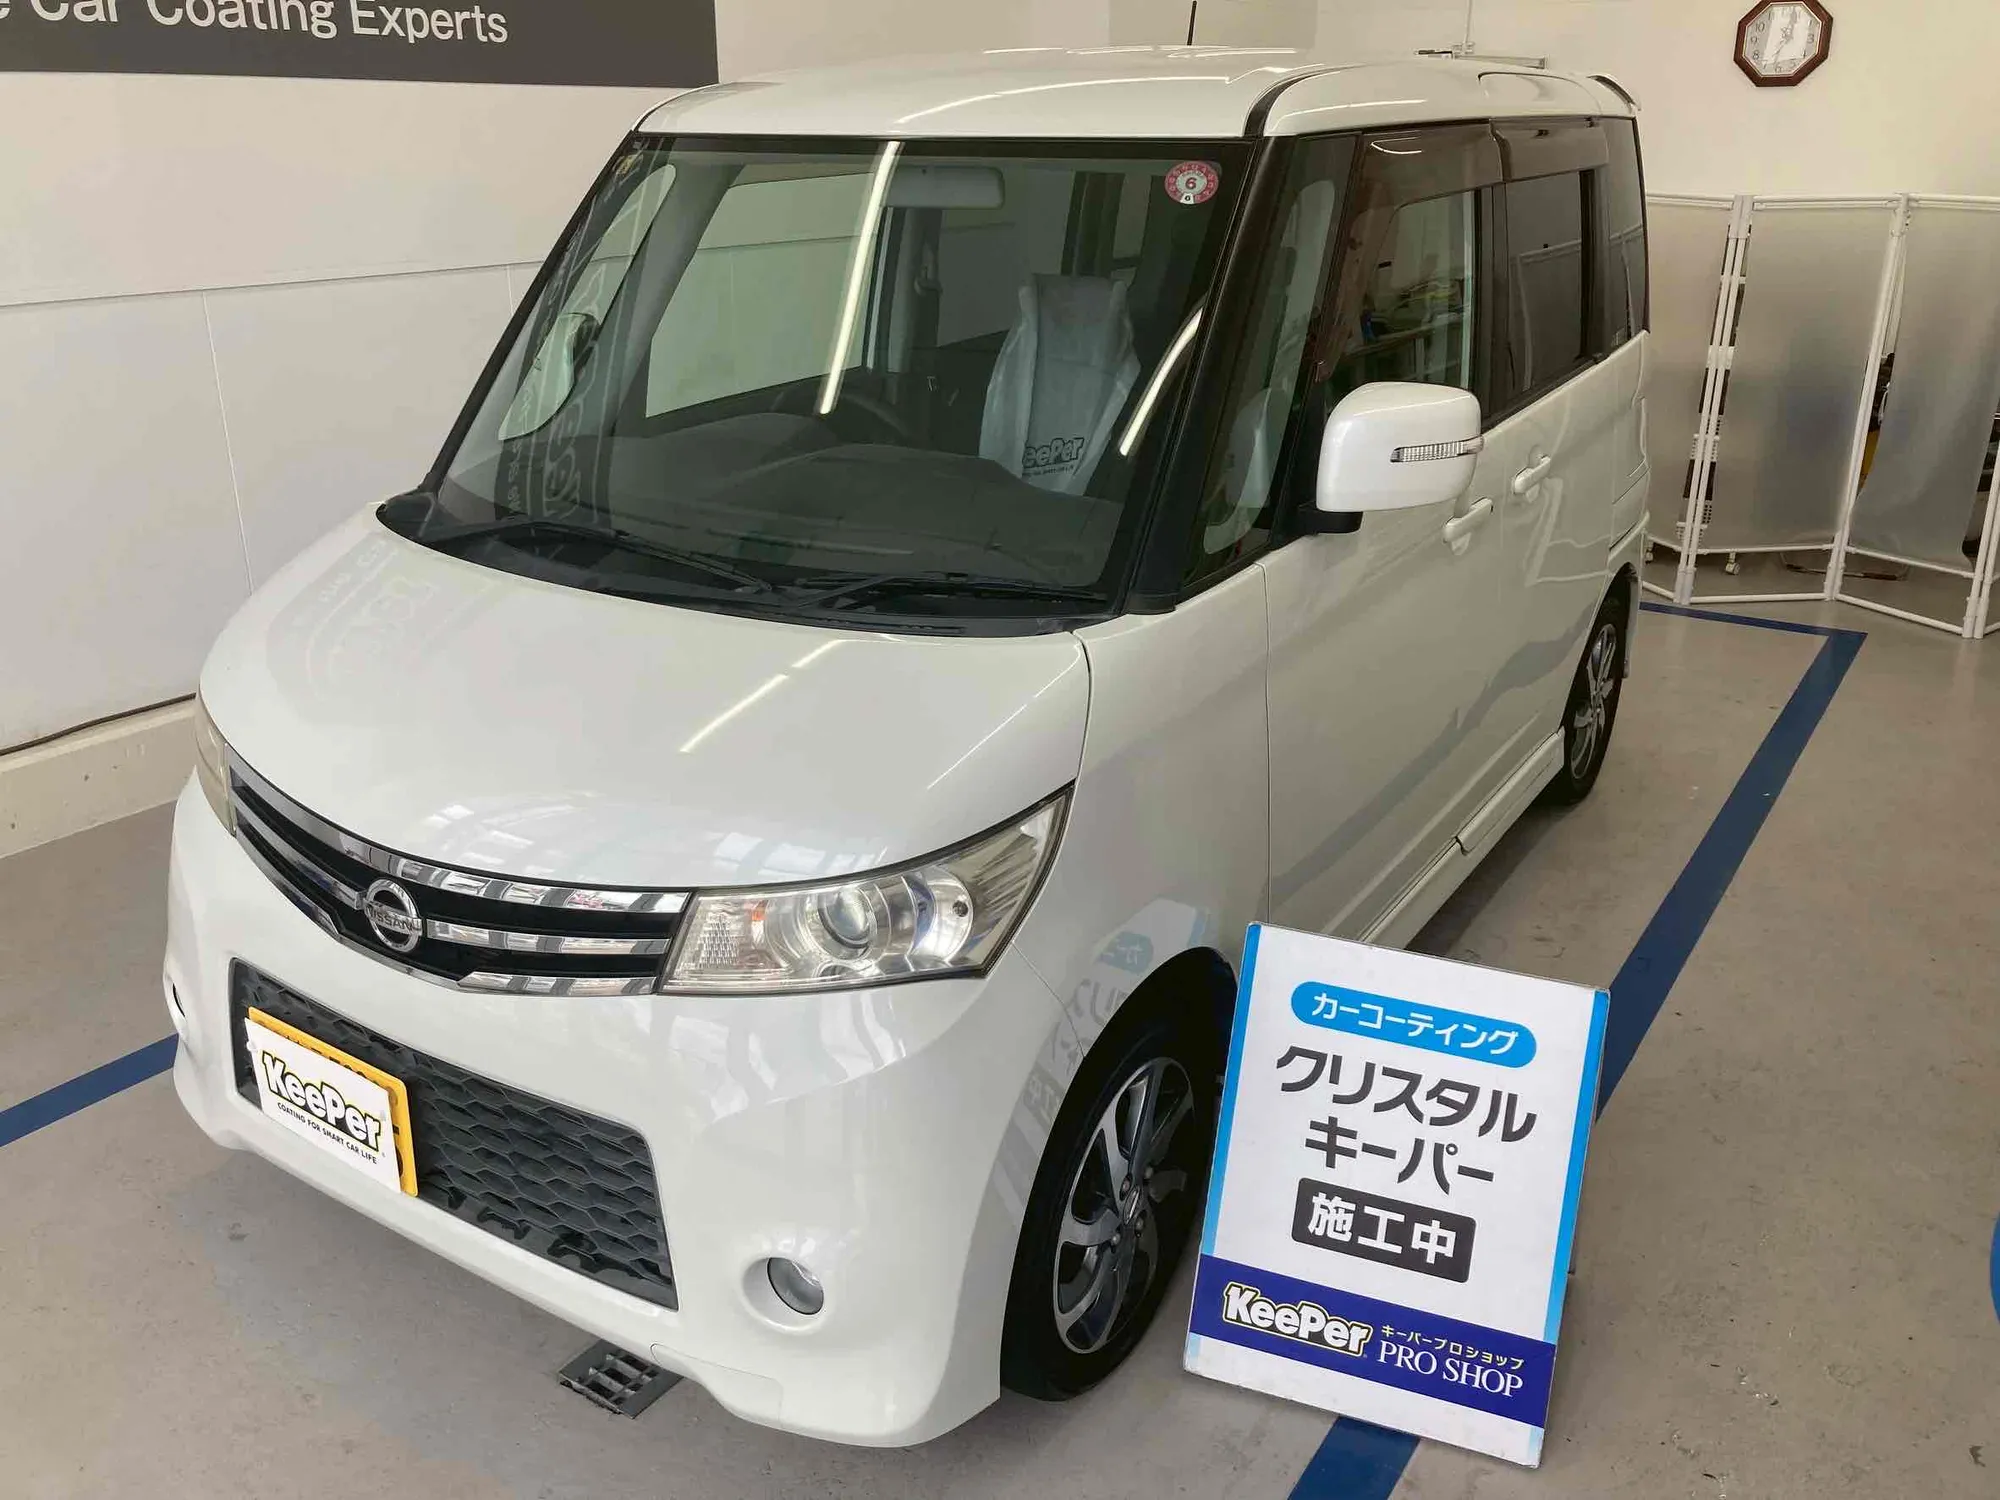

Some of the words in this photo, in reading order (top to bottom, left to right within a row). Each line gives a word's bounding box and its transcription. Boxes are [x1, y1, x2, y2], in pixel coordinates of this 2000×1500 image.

[146, 0, 338, 39] Coating
[350, 0, 508, 44] Experts
[1185, 177, 1197, 190] 6
[1022, 436, 1085, 469] eePer
[365, 903, 413, 932] NISSAN
[1312, 993, 1519, 1056] カーコーティング
[262, 1051, 382, 1152] KeePer
[1276, 1045, 1538, 1143] クリスタル
[277, 1102, 306, 1124] COATING
[307, 1119, 321, 1132] FOR
[322, 1127, 344, 1145] SMART
[346, 1141, 360, 1154] CAR
[361, 1152, 377, 1164] LIFE
[1305, 1116, 1495, 1196] キーパー
[1308, 1191, 1457, 1265] 施工中
[1223, 1281, 1373, 1357] KeePer
[1376, 1340, 1438, 1375] PRO
[1443, 1357, 1524, 1398] SHOP
